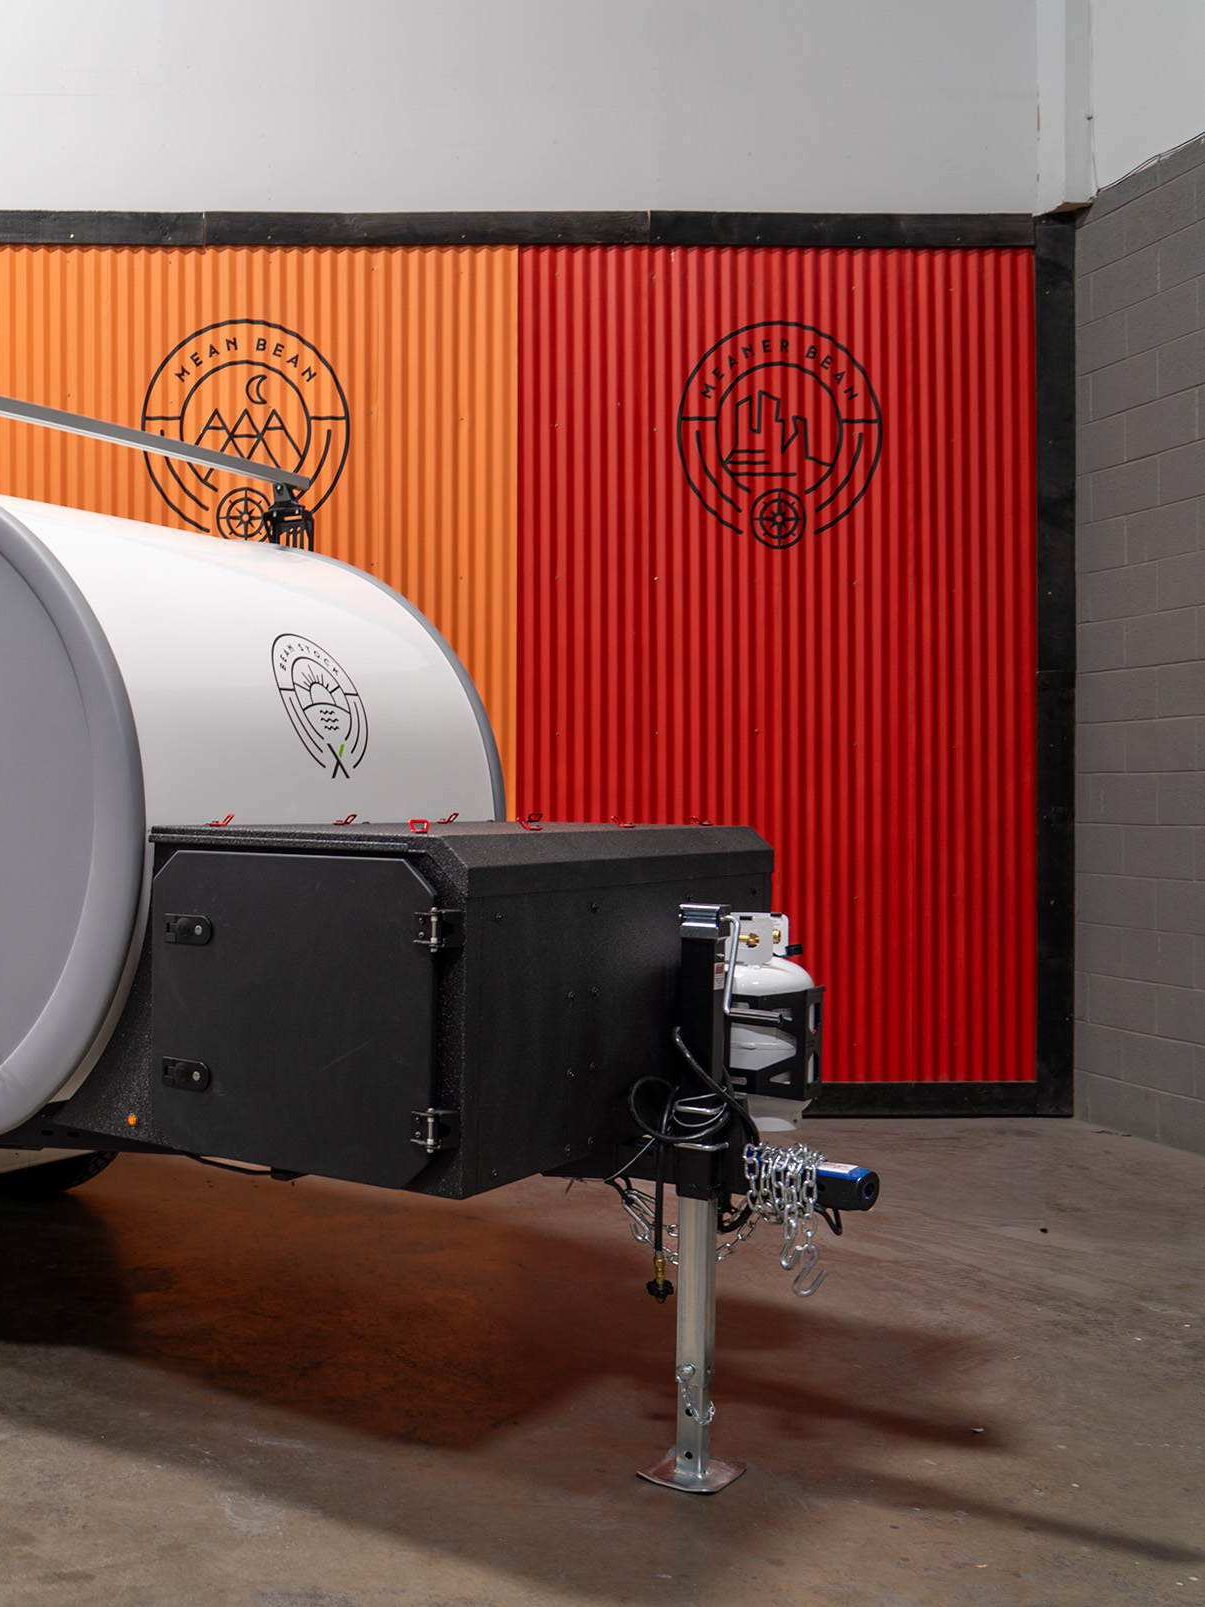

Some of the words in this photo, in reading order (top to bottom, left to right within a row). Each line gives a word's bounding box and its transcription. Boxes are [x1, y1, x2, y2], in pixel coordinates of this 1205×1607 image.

[174, 337, 238, 383] MEAN
[255, 337, 317, 383] BEAN
[700, 338, 790, 399] MEANER
[804, 345, 858, 401] BEAN
[279, 643, 295, 672] BEAN
[297, 643, 340, 676] STOCK
